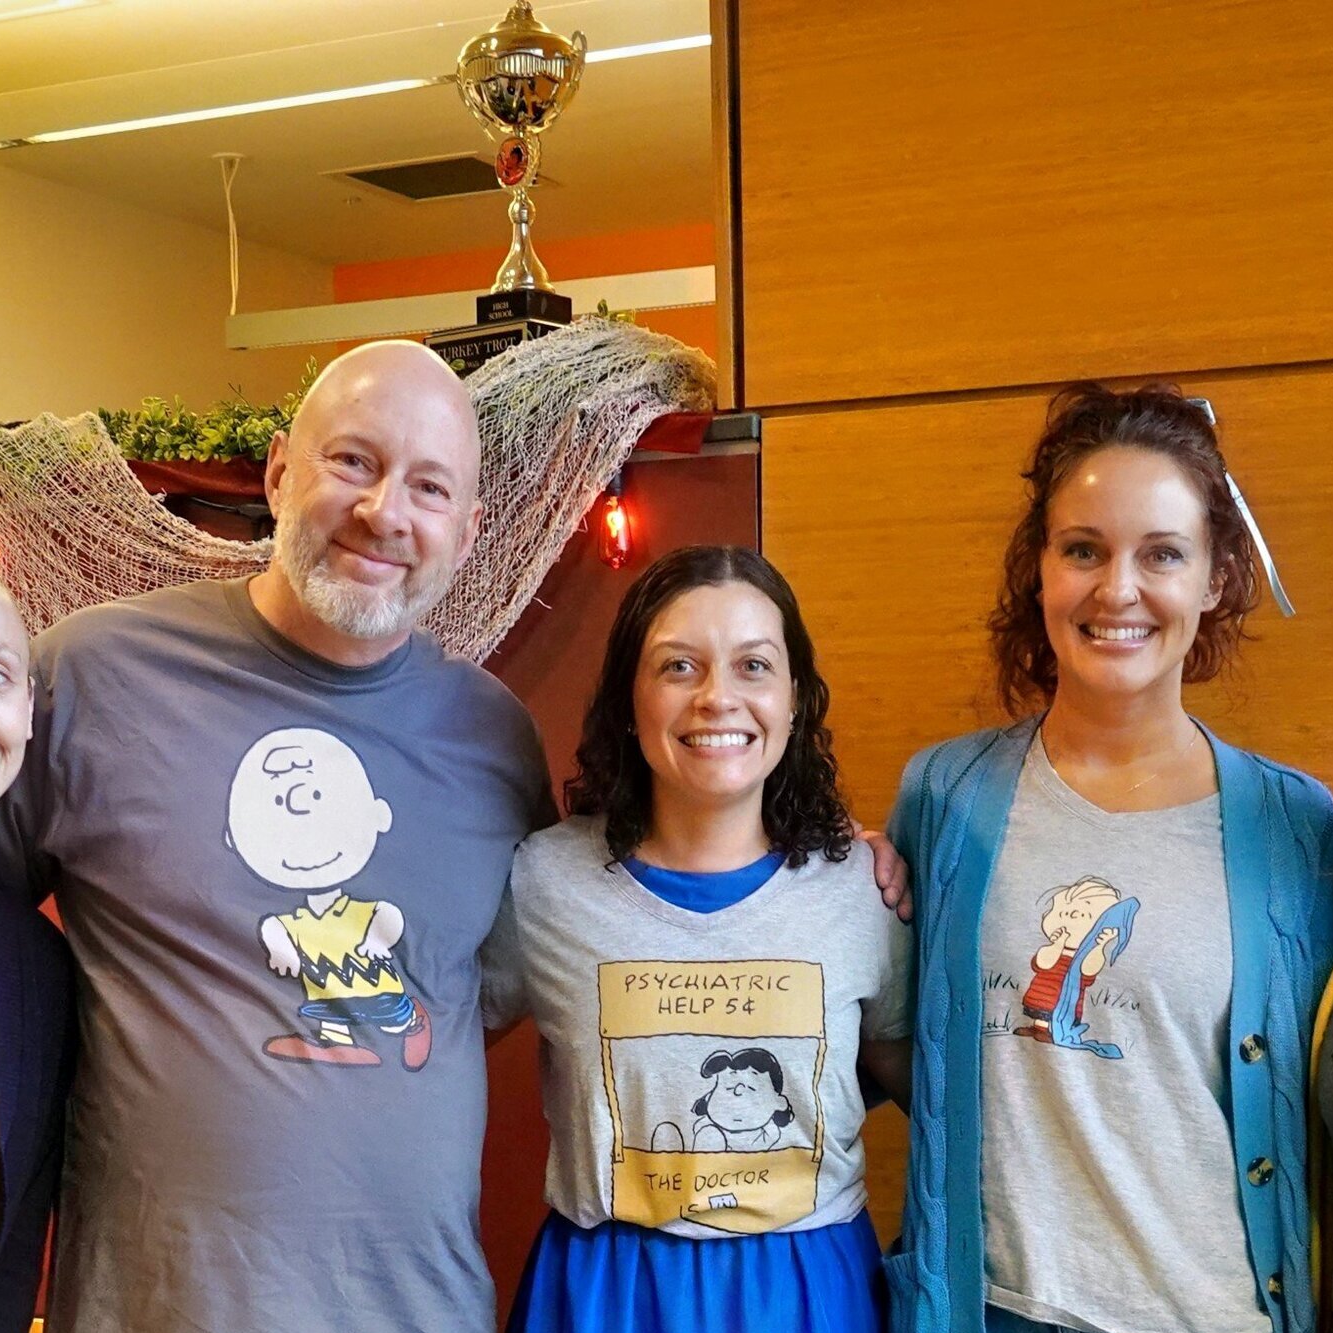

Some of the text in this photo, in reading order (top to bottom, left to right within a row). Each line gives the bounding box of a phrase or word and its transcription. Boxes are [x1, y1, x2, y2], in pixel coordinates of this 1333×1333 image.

[437, 337, 517, 360] TURKEY TROT
[624, 972, 791, 993] PSYCHIATRIC
[658, 996, 756, 1015] HELP 5¢
[644, 1168, 770, 1193] THE DOCTOR
[679, 1203, 700, 1219] IS
